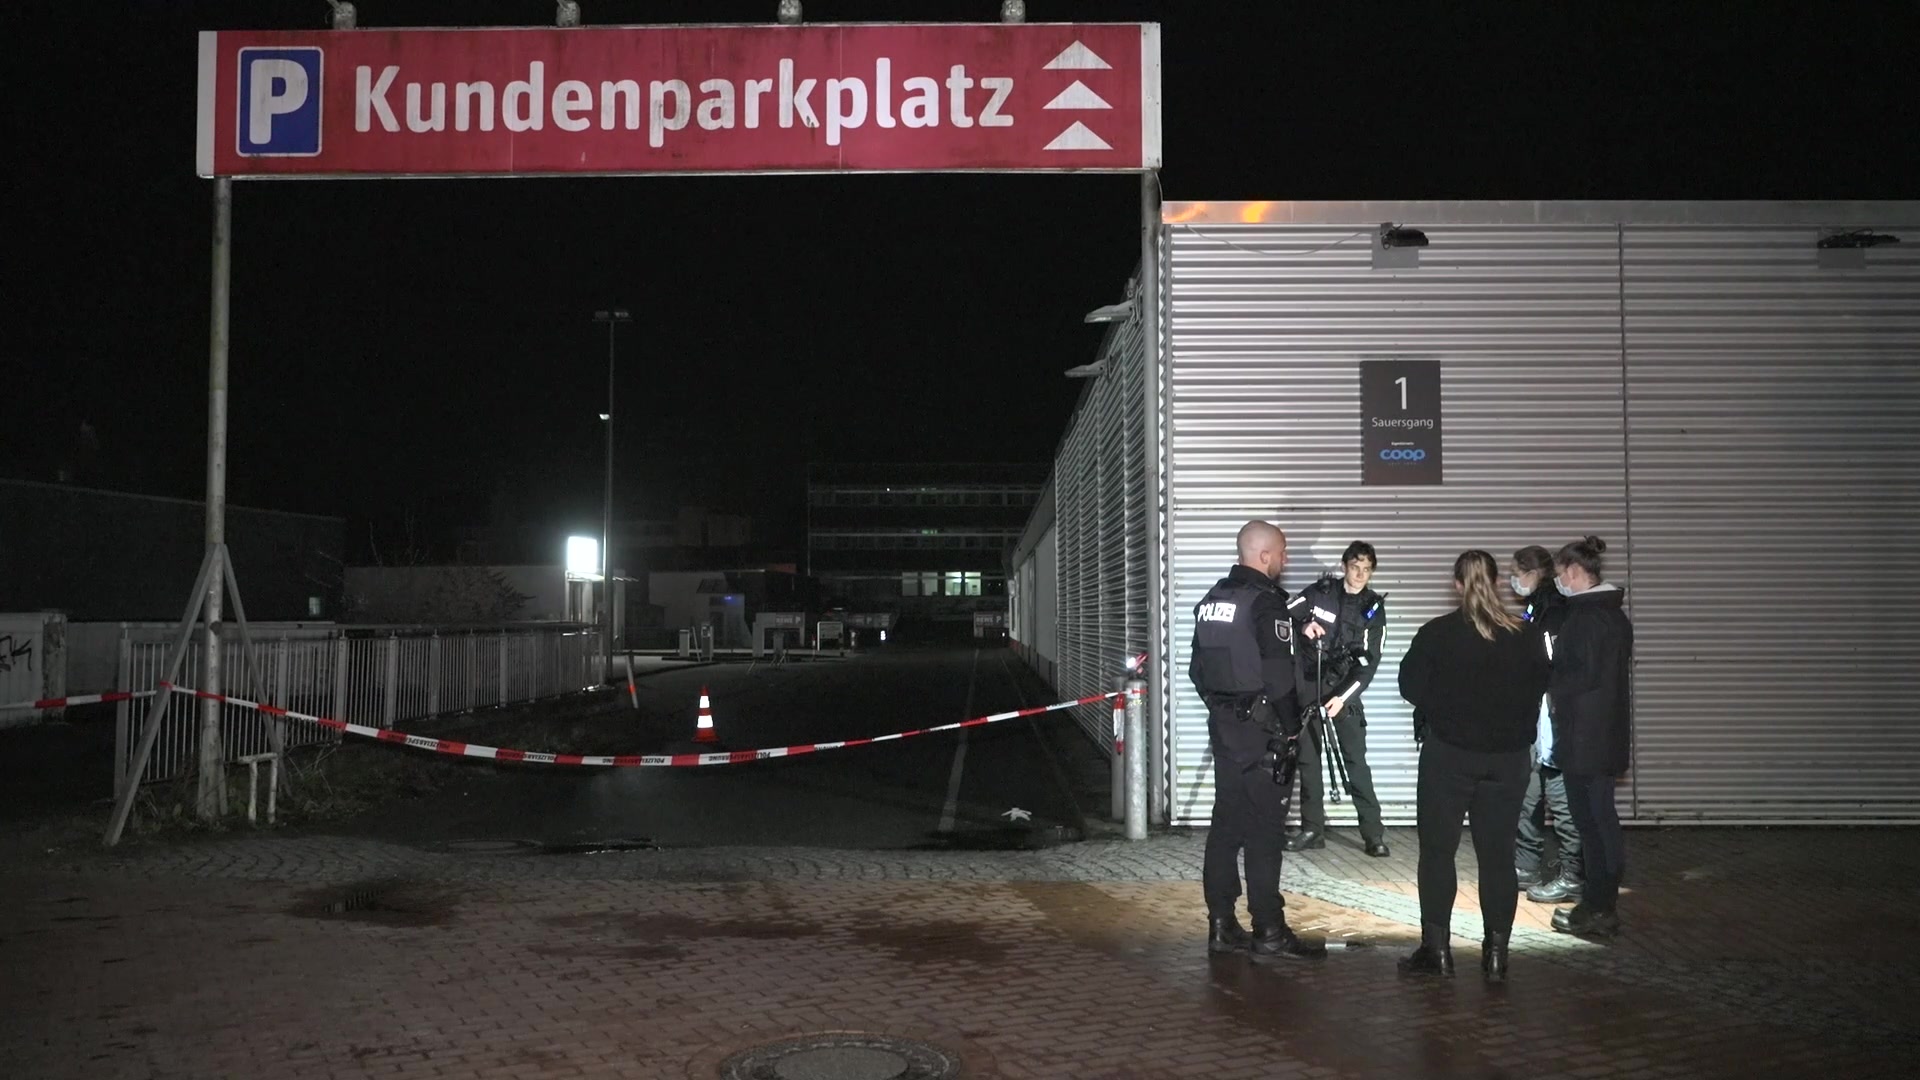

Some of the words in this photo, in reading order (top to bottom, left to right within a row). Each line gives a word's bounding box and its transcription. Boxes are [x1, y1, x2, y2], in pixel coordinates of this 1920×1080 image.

[249, 59, 309, 145] P
[354, 57, 1014, 148] Kundenparkplatz
[1394, 376, 1407, 410] 1
[1371, 416, 1434, 430] Sauersgang
[1380, 448, 1426, 462] coop
[1197, 602, 1237, 623] POLIZEI
